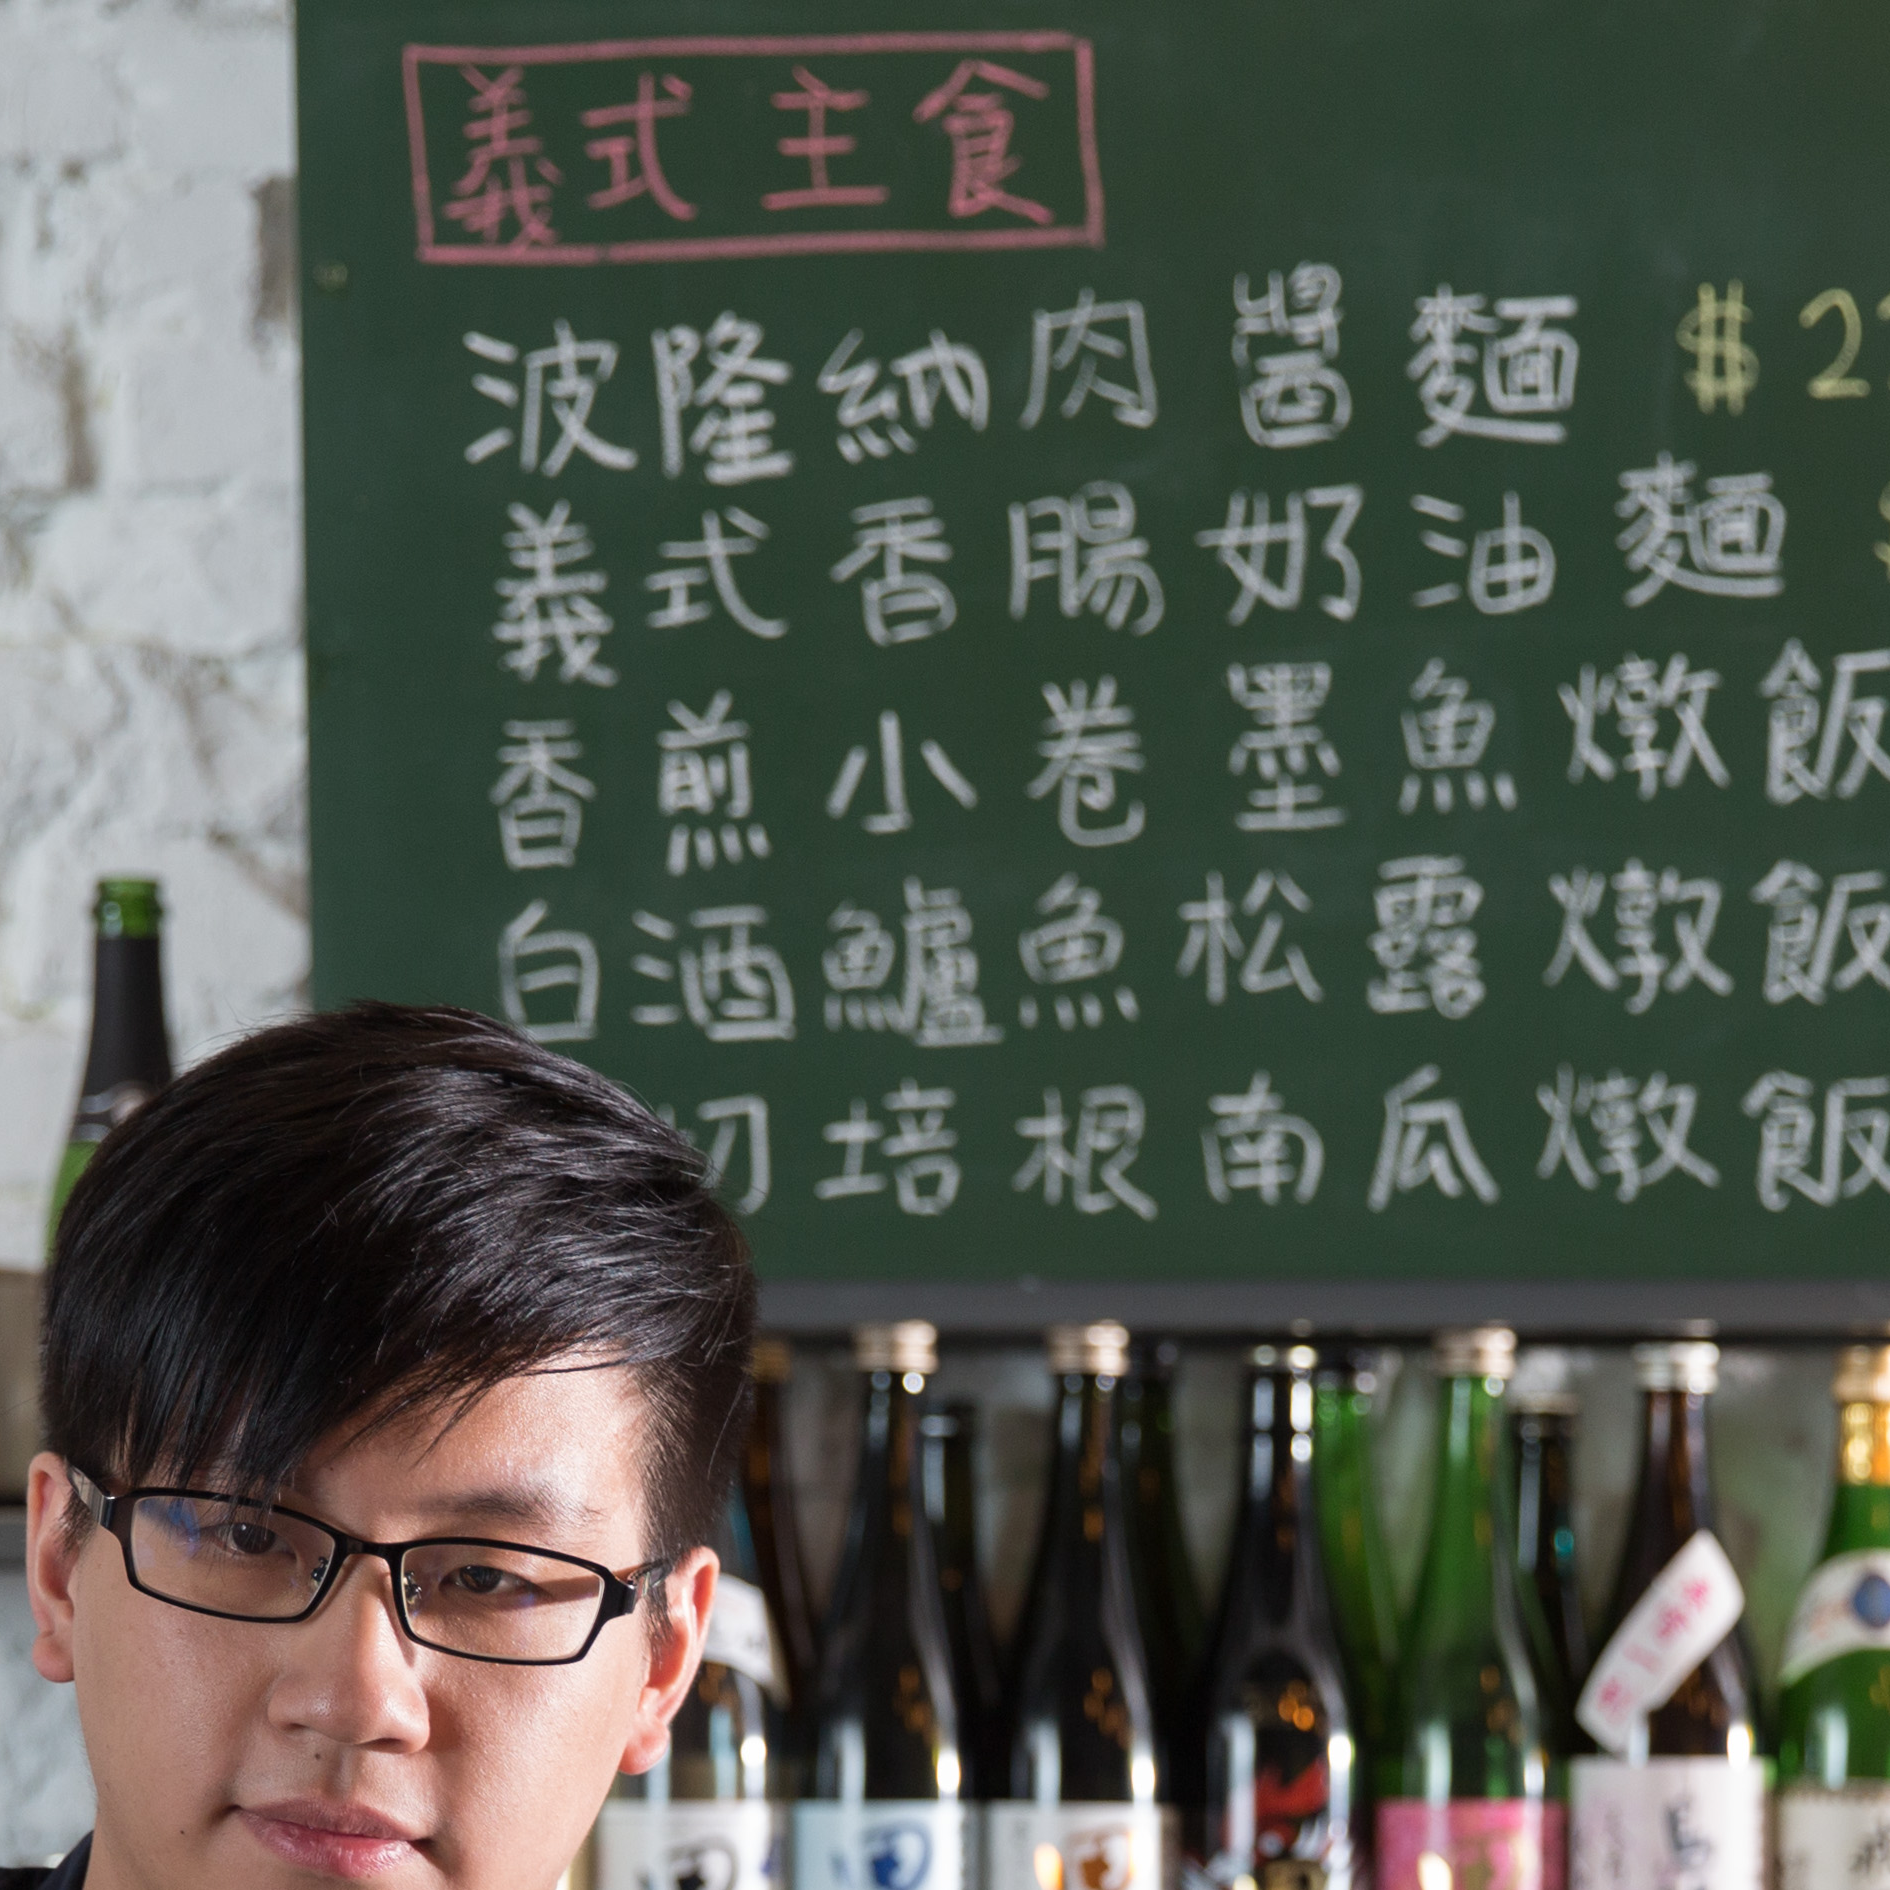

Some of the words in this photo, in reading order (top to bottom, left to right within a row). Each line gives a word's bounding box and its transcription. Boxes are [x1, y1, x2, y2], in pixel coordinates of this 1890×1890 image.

[447, 60, 1054, 246] 義式主食
[463, 260, 1578, 486] 波隆納肉醬麵
[493, 452, 1786, 686] 義式香腸奶油麵
